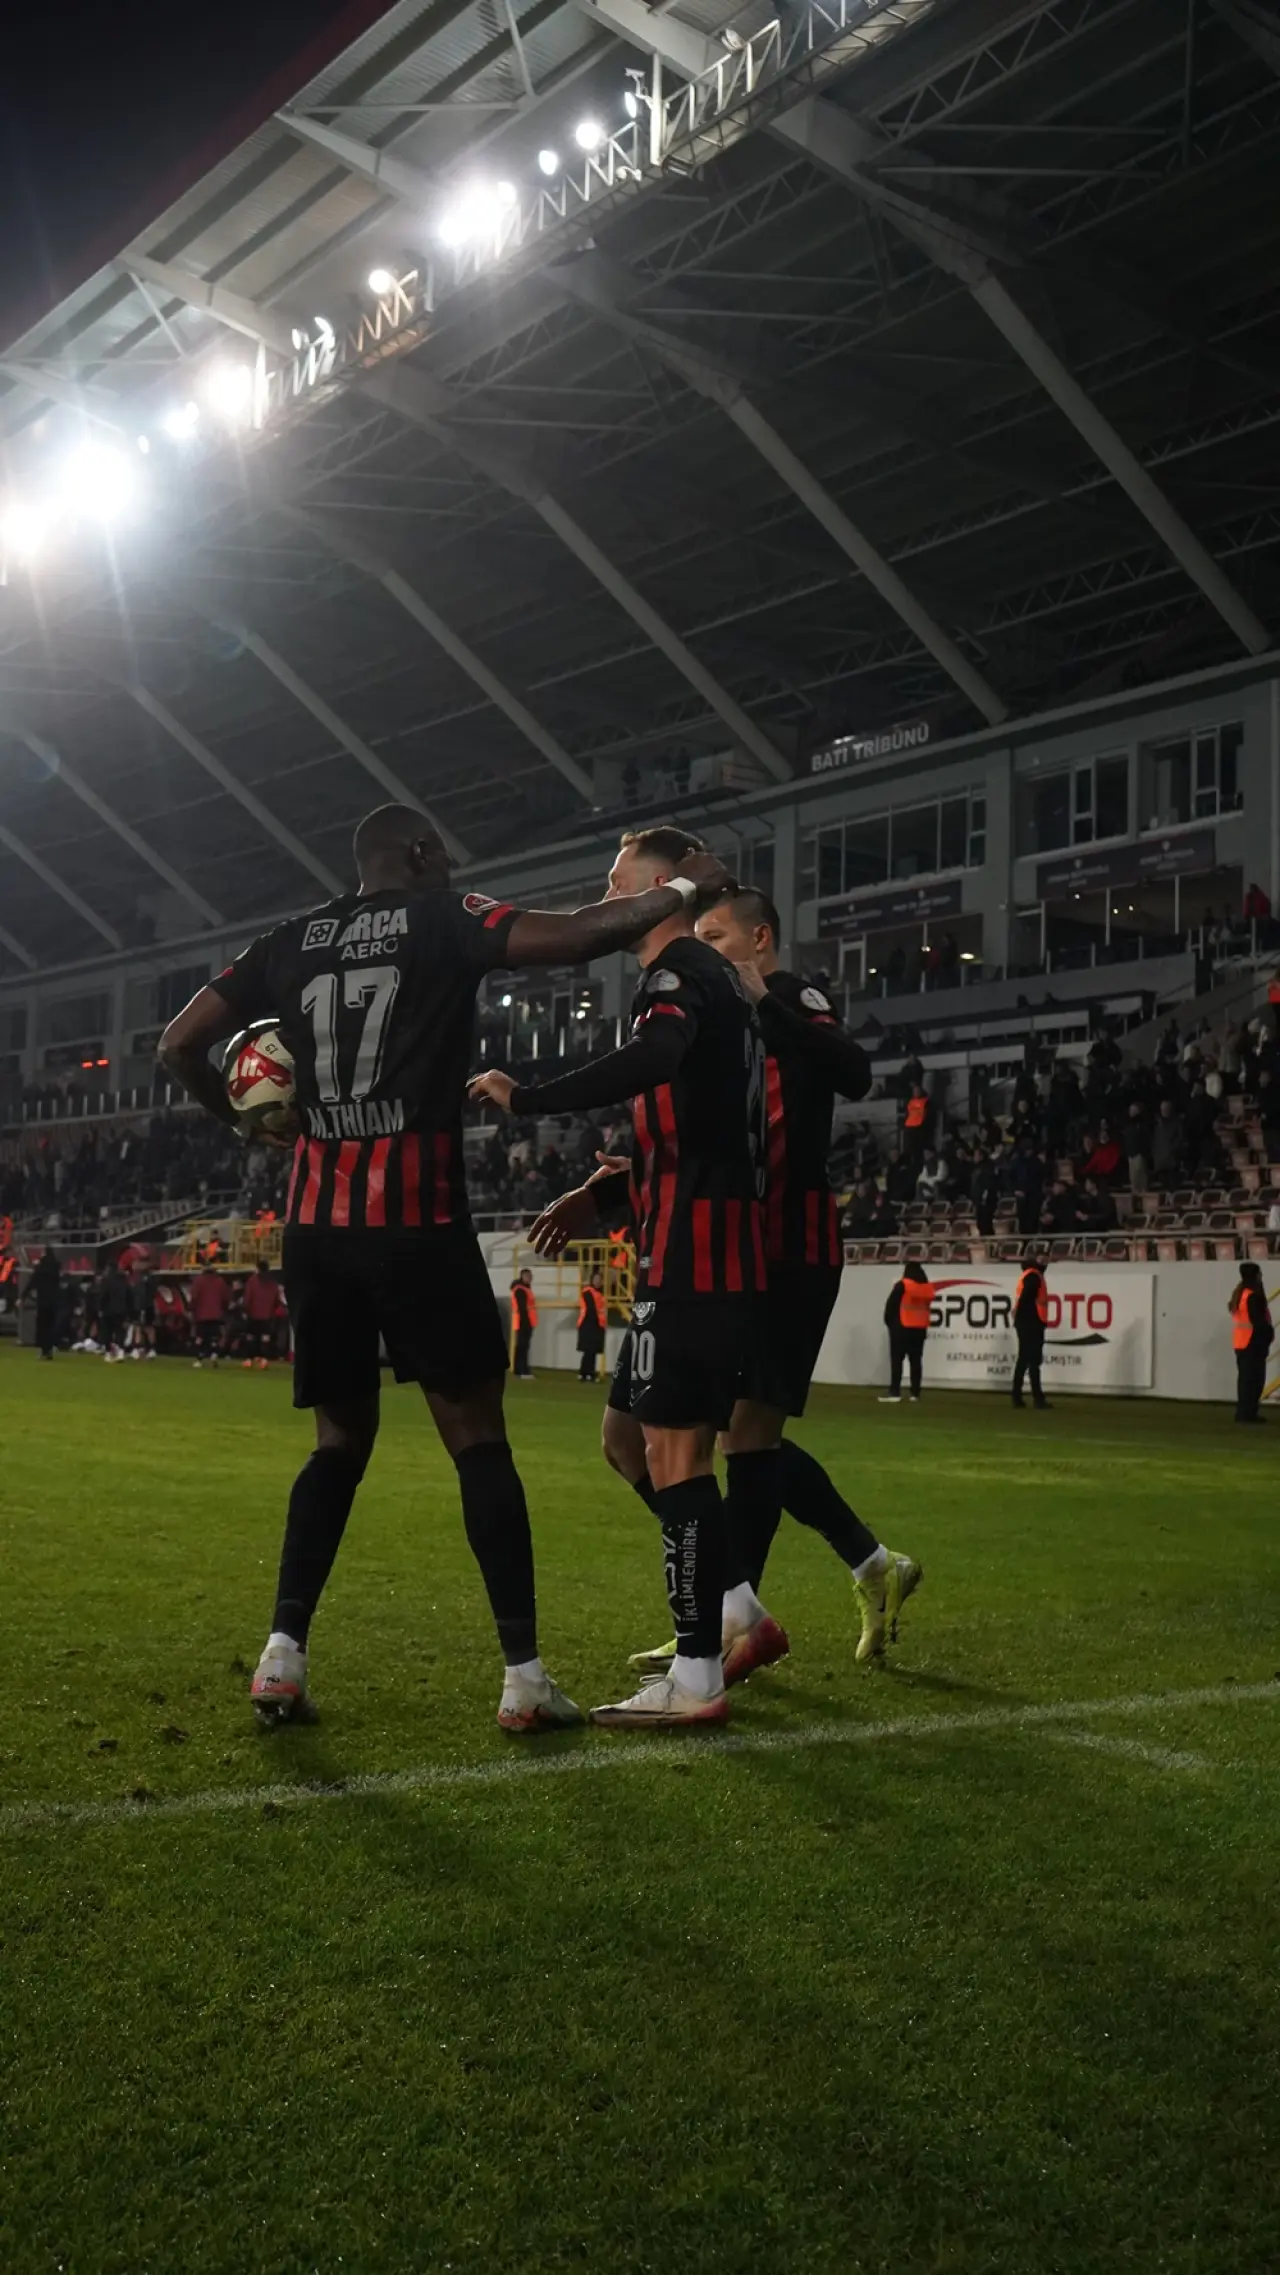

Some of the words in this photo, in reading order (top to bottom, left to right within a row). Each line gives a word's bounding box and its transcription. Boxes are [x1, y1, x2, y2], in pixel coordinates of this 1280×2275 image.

[811, 747, 849, 773] BATI
[336, 907, 408, 947] ARCA
[340, 937, 399, 961] AERO
[301, 965, 400, 1103] 17
[306, 1098, 405, 1140] M.THIAM
[930, 1295, 1011, 1328] SPOR
[1047, 1293, 1113, 1330] OTO
